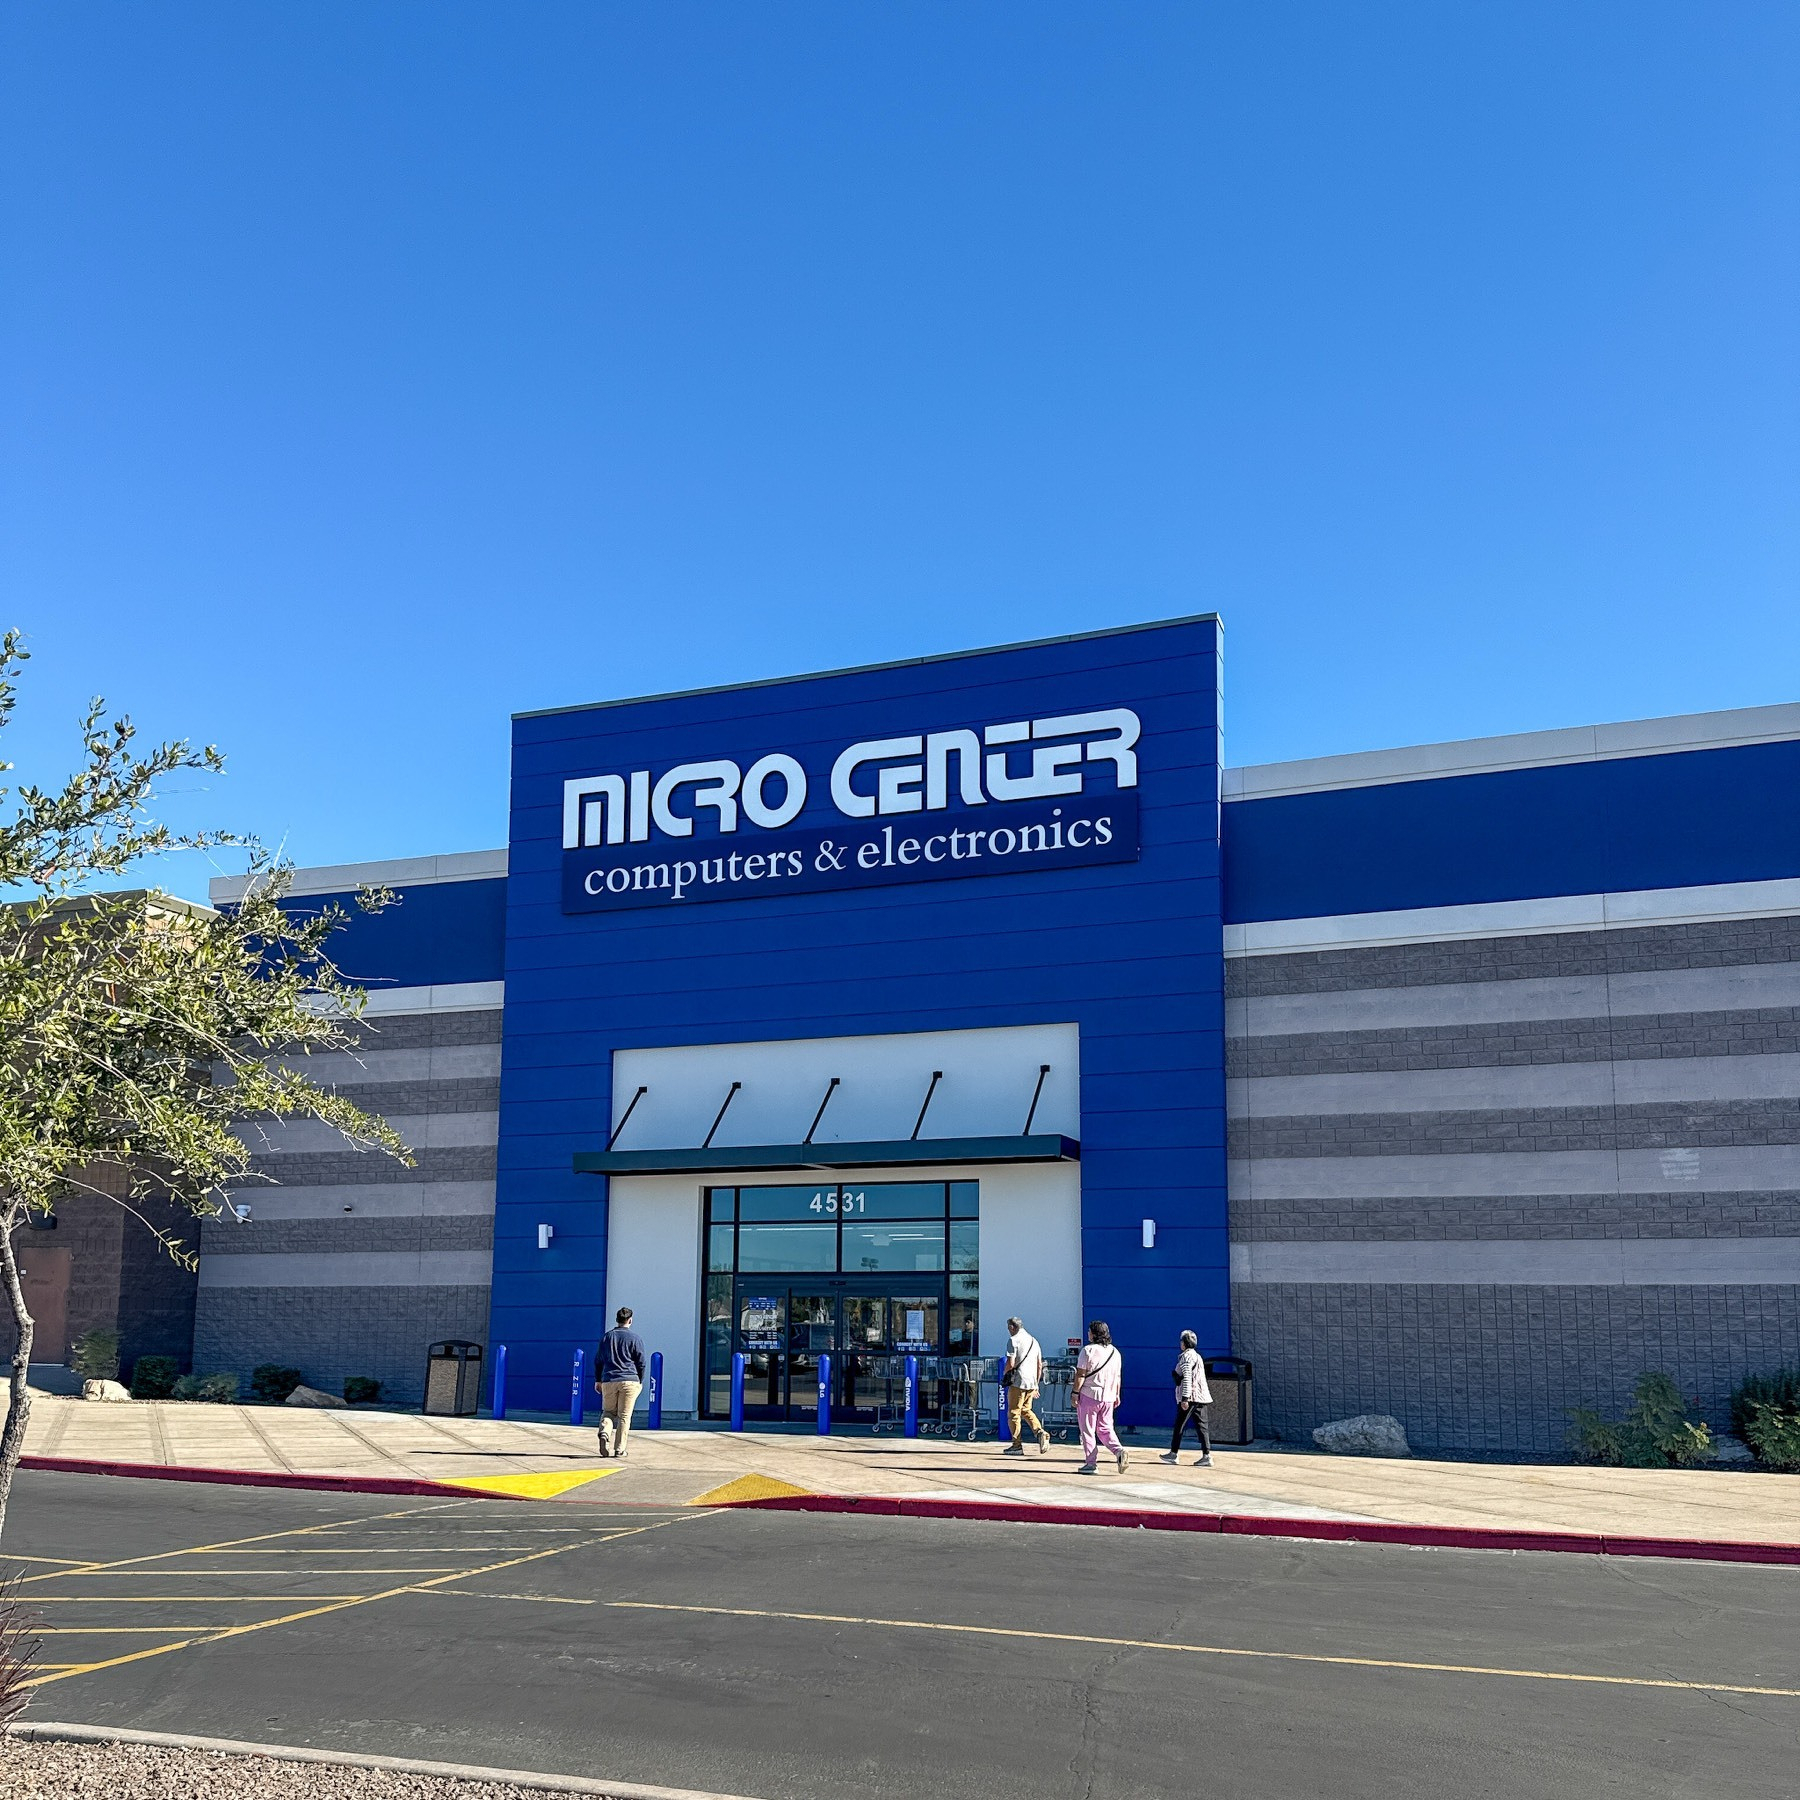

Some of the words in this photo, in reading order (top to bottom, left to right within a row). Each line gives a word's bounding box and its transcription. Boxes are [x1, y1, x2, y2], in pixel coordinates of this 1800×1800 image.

[563, 754, 807, 849] MICRO
[831, 708, 1141, 818] CENTER
[585, 850, 803, 900] computers
[815, 840, 848, 872] &
[857, 808, 1113, 869] electronics
[810, 1192, 865, 1213] 4531
[572, 1361, 580, 1396] RZER
